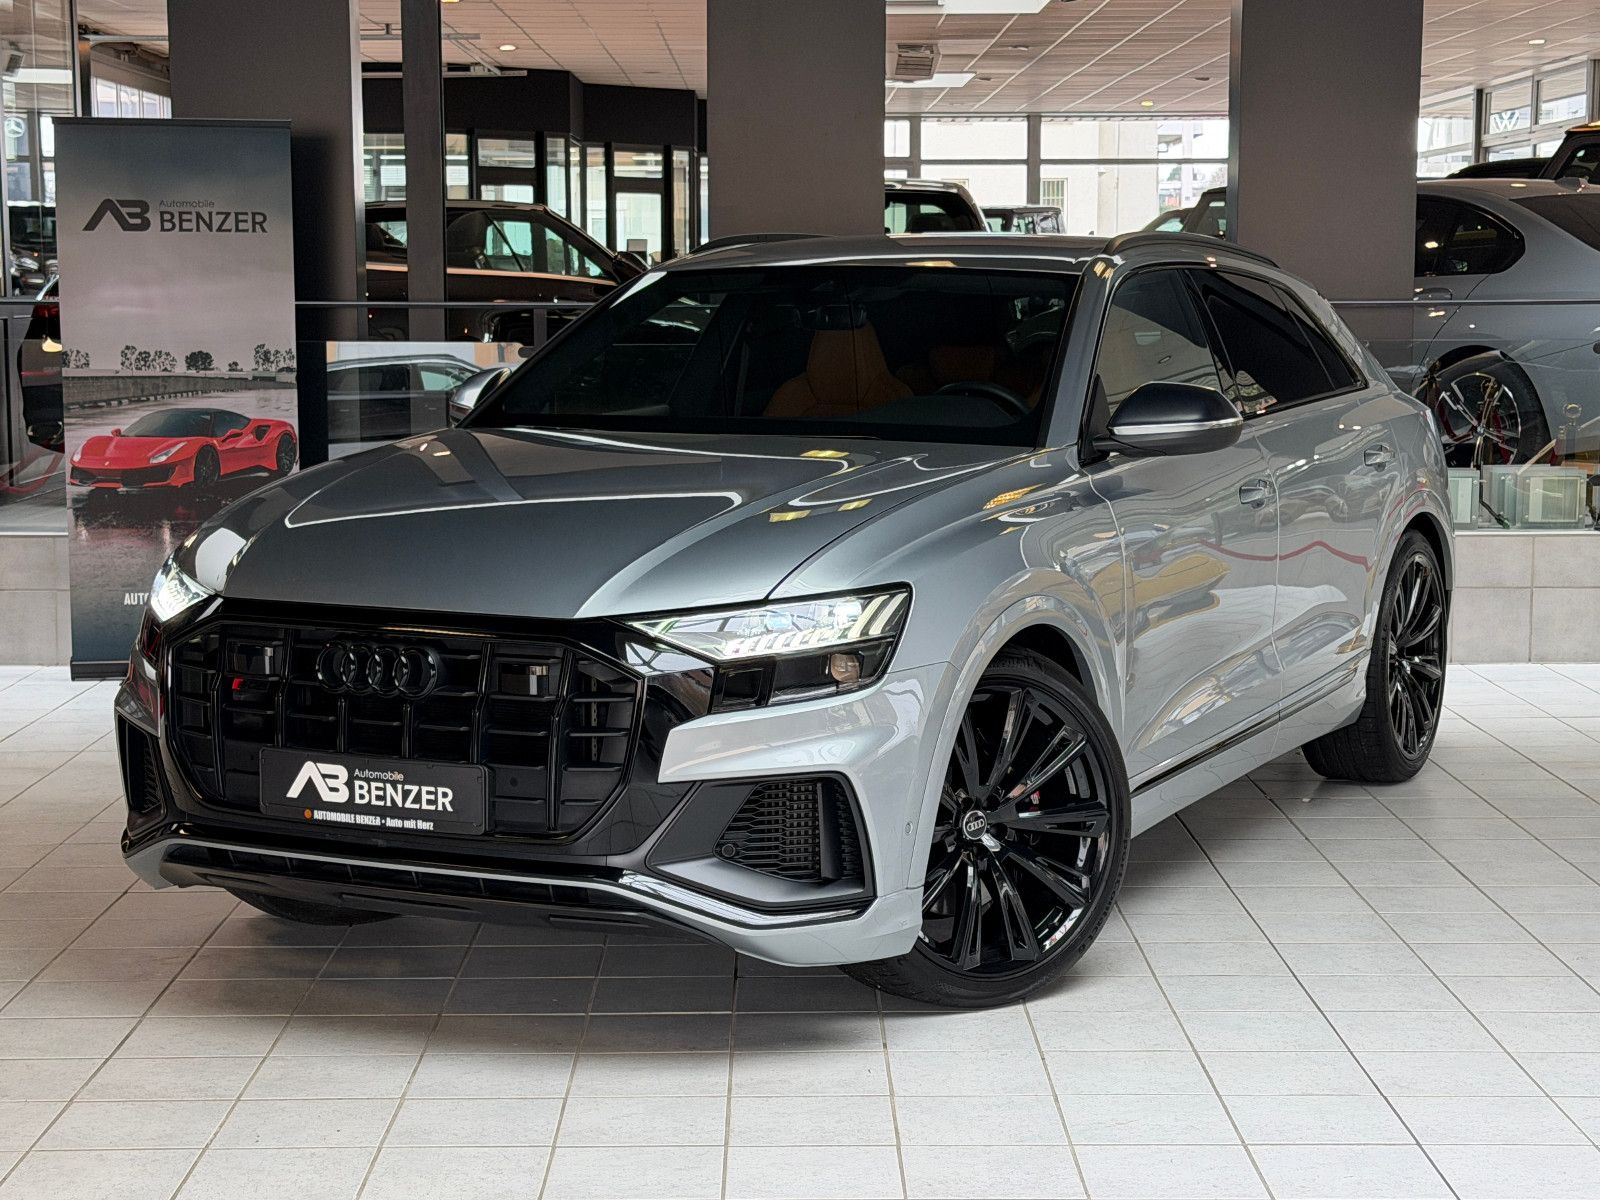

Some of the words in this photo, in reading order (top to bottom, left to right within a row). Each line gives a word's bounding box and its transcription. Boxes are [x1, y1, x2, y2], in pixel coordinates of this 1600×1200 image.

[159, 200, 215, 209] Automobile
[159, 211, 268, 233] BENZER
[353, 768, 404, 781] Automobile
[353, 780, 454, 812] BENZER
[313, 809, 355, 824] AUTOMOBILE
[355, 814, 381, 826] BENZER
[386, 817, 403, 828] Auto
[403, 819, 417, 829] mit
[417, 820, 434, 831] Herz
